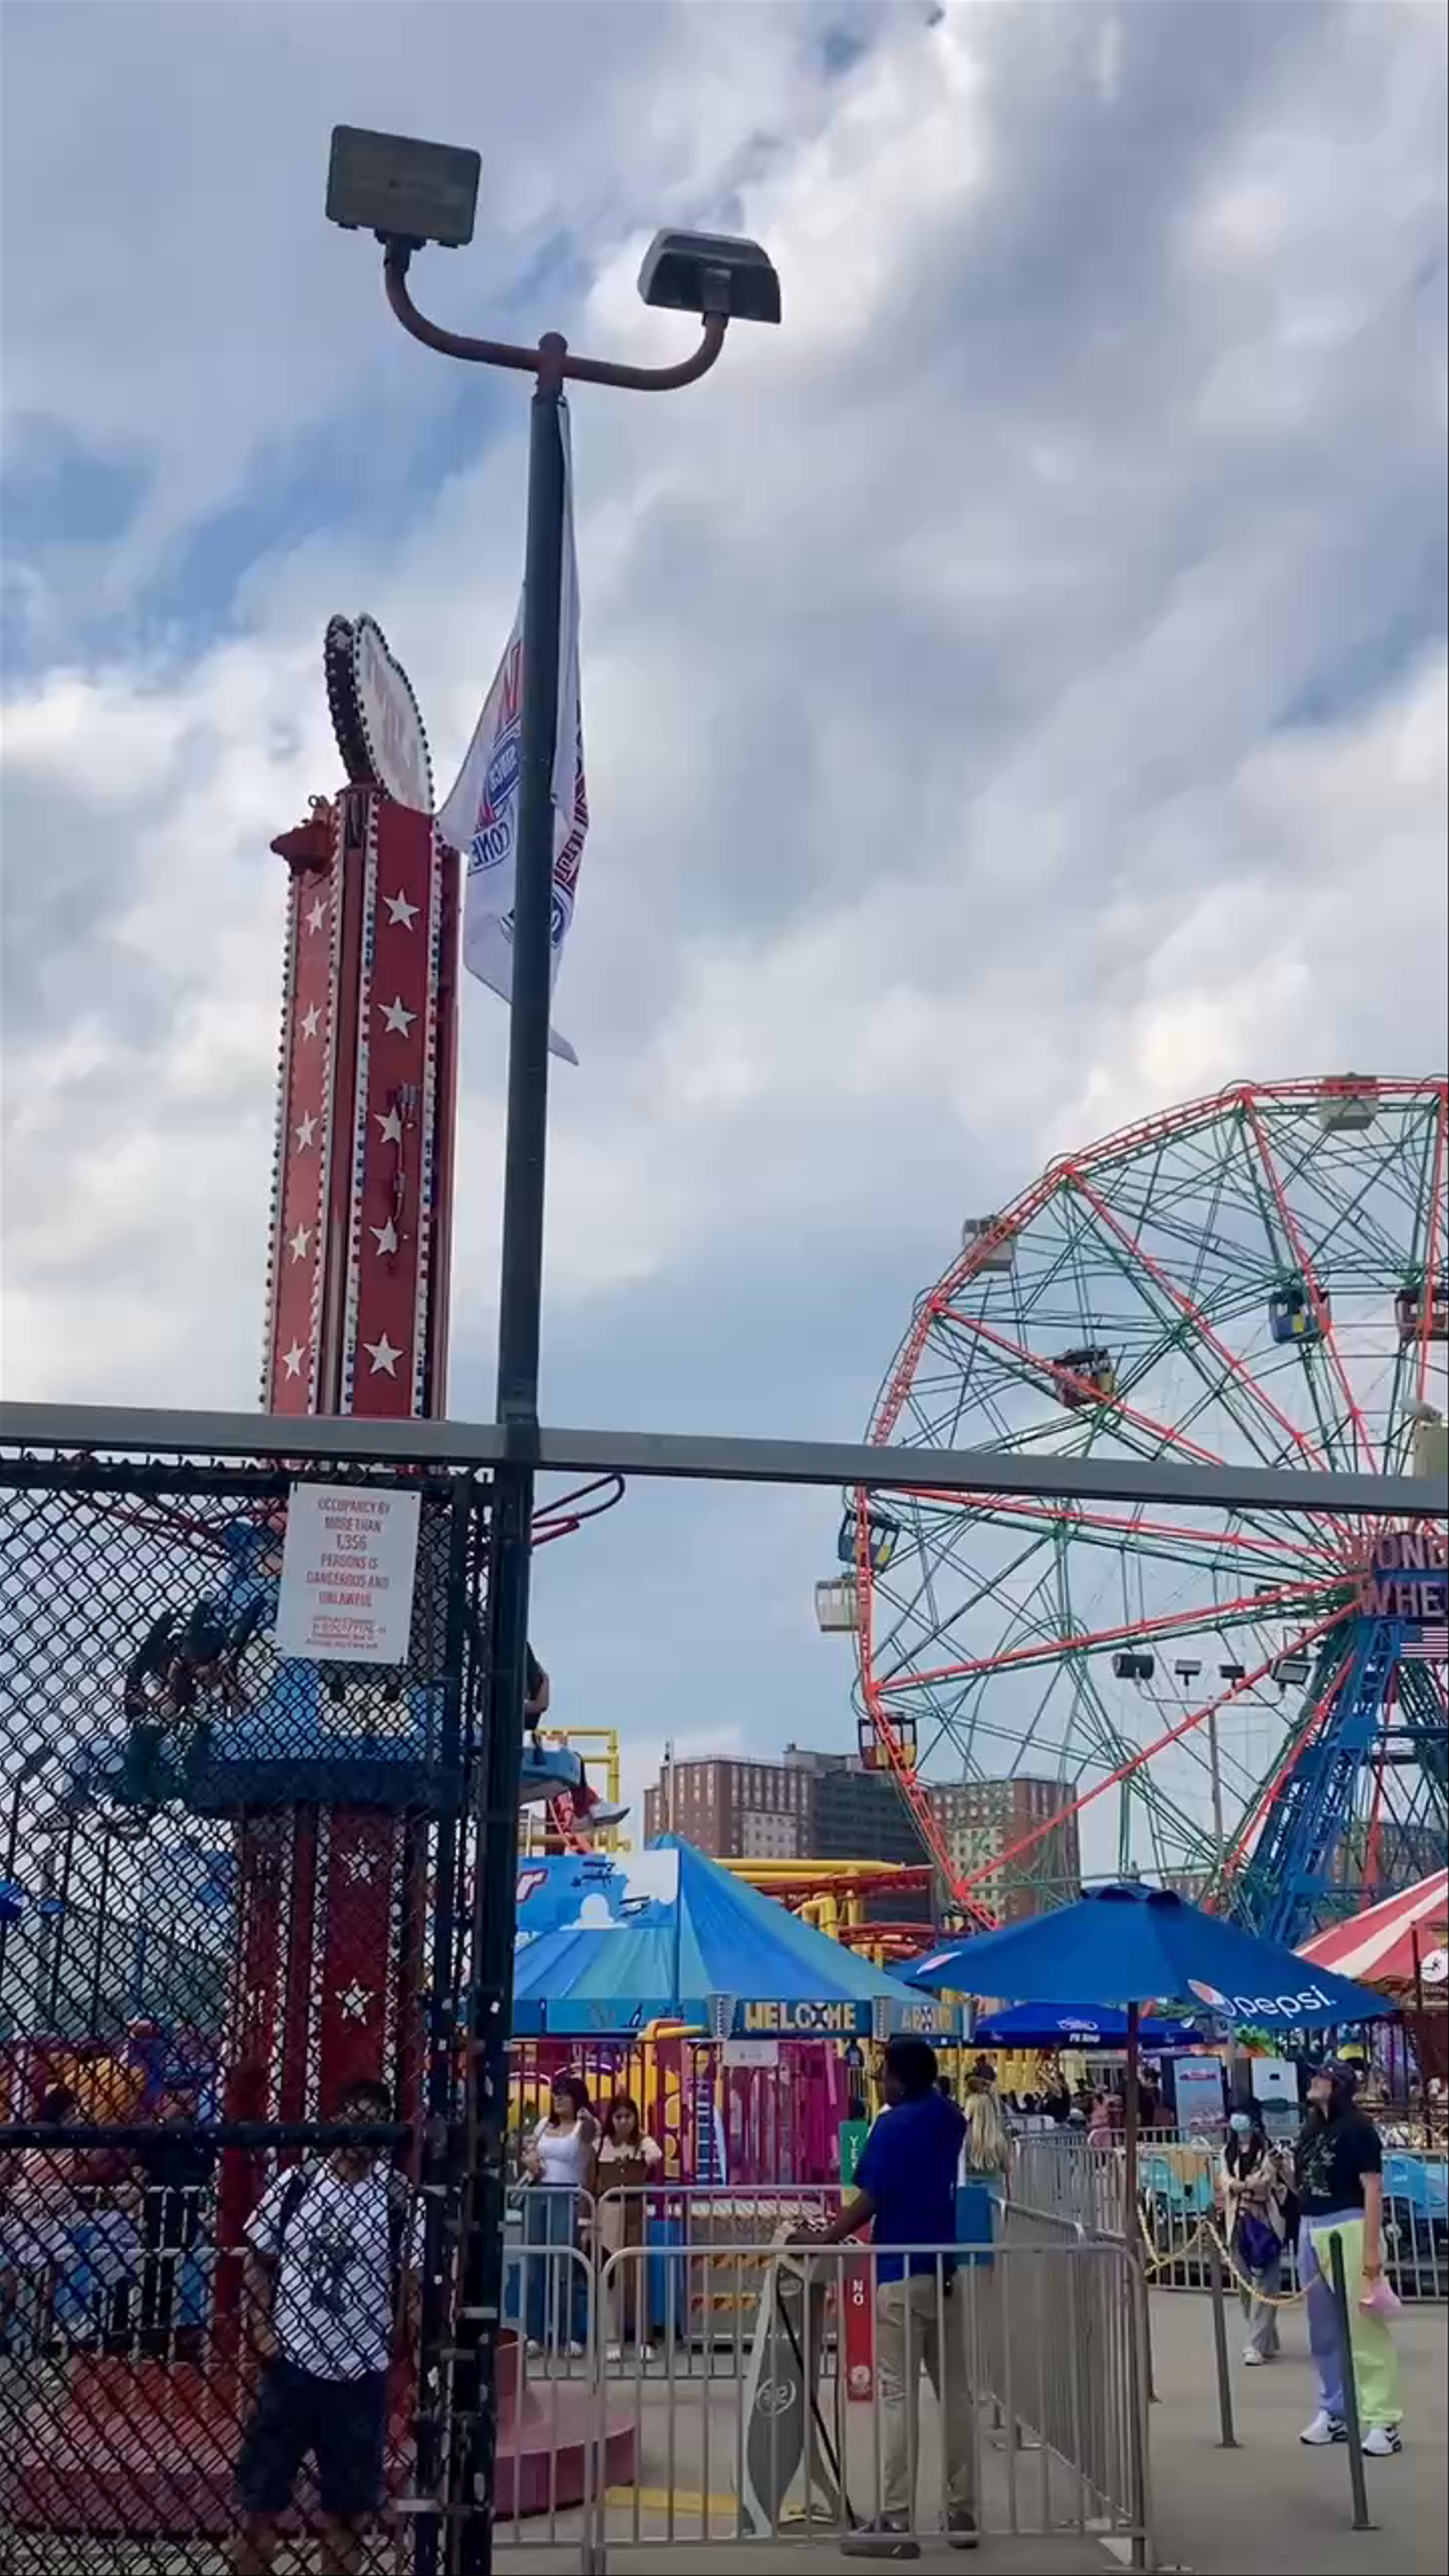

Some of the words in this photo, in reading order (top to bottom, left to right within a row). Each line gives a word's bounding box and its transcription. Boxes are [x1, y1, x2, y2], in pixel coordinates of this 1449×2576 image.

[318, 1498, 377, 1513] OCCUPANCY
[378, 1502, 390, 1515] BY
[325, 1516, 353, 1531] MORE
[355, 1520, 381, 1533] THAN
[321, 1553, 366, 1569] PERSONS
[368, 1558, 378, 1569] IS
[306, 1571, 366, 1587] DANGEROUS
[368, 1576, 389, 1589] AND
[319, 1591, 372, 1607] UNLAWFUL
[1234, 1984, 1332, 2019] pepsi
[744, 2003, 855, 2029] WELCOME
[853, 2279, 864, 2306] NO
